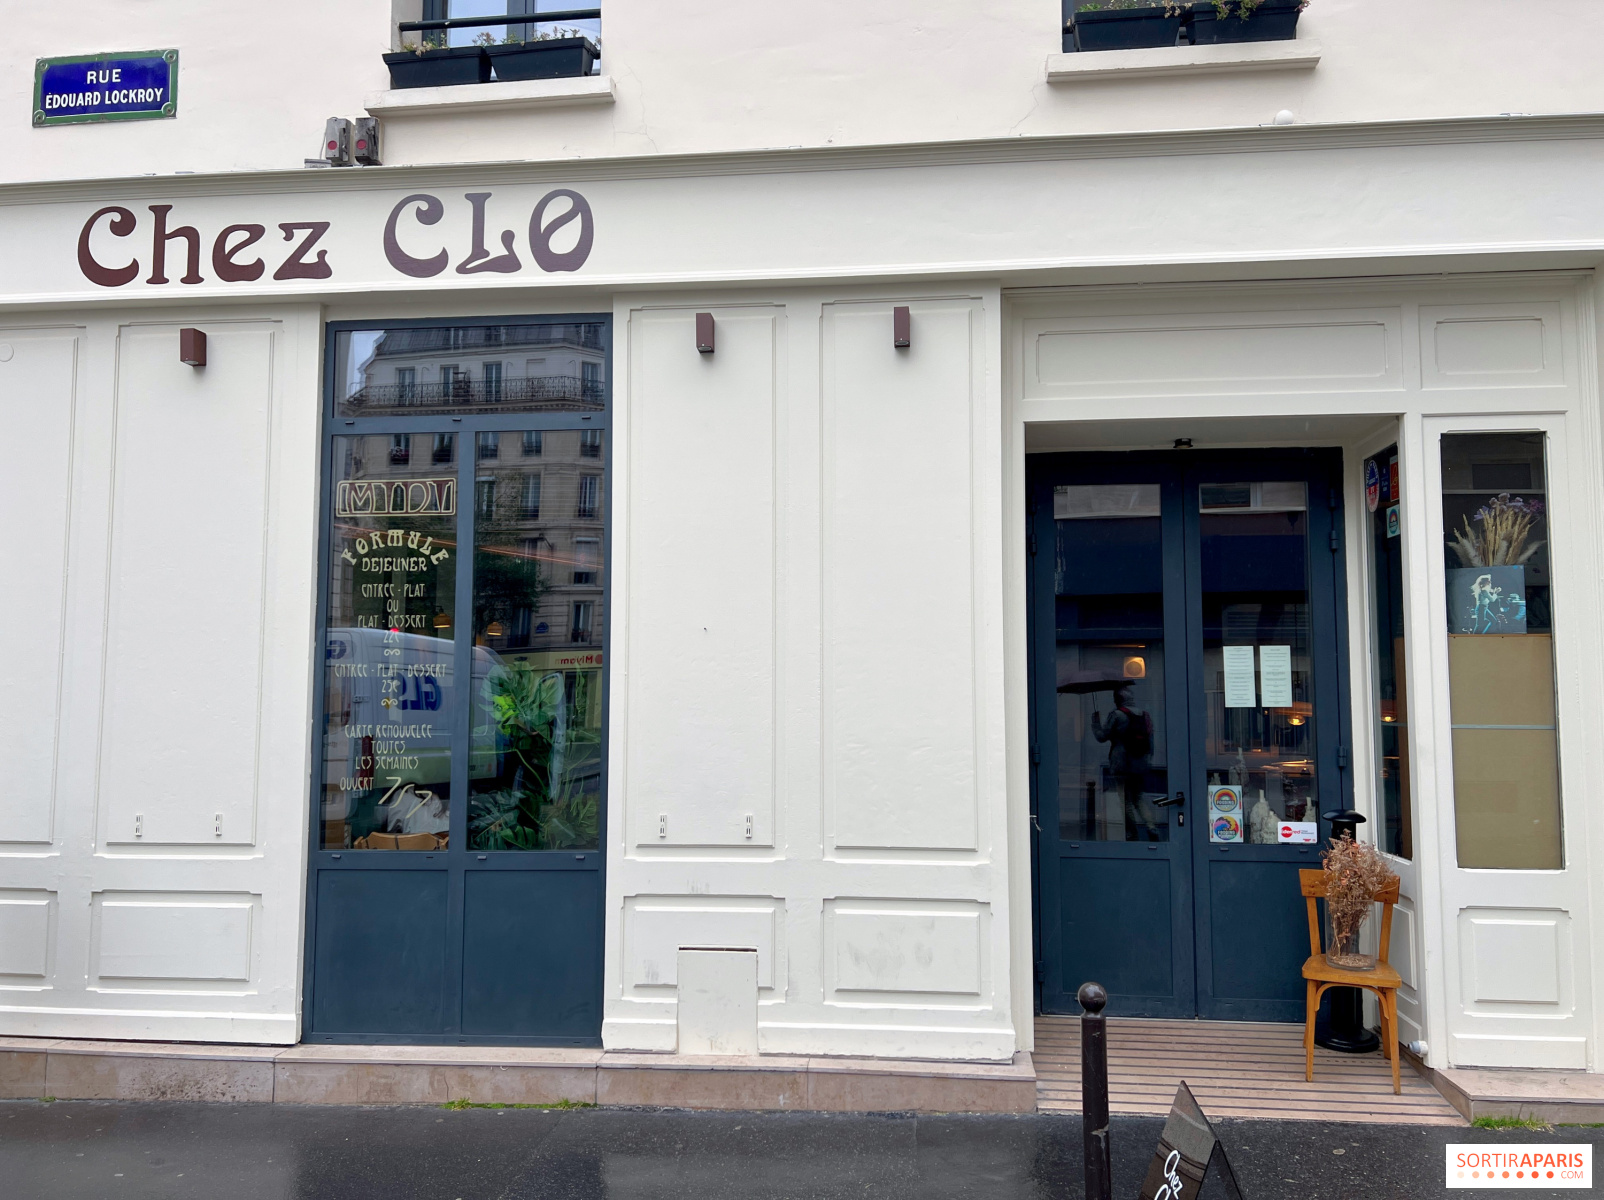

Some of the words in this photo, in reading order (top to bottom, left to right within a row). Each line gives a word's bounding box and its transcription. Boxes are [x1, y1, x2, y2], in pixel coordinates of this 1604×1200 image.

[86, 69, 122, 84] RUE
[45, 92, 101, 109] ÉDOUARD
[104, 87, 164, 104] LOCKROY
[77, 204, 333, 287] Chez
[383, 188, 595, 278] CLO
[345, 481, 450, 514] MIDI
[340, 529, 449, 566] FORMULE
[361, 556, 428, 574] DEJEUNER
[403, 583, 426, 598] PLAT
[386, 599, 399, 613] OU
[357, 614, 379, 628] PLAT
[388, 614, 426, 628] DESSERT
[377, 663, 398, 677] PLAT
[407, 663, 447, 678] DESSERT
[344, 724, 373, 738] CARTE
[371, 740, 406, 754] TOUTES
[355, 756, 372, 769] LES
[375, 756, 419, 769] SEMAINES
[339, 777, 374, 791] OUVERT
[1163, 1149, 1184, 1200] Chez
